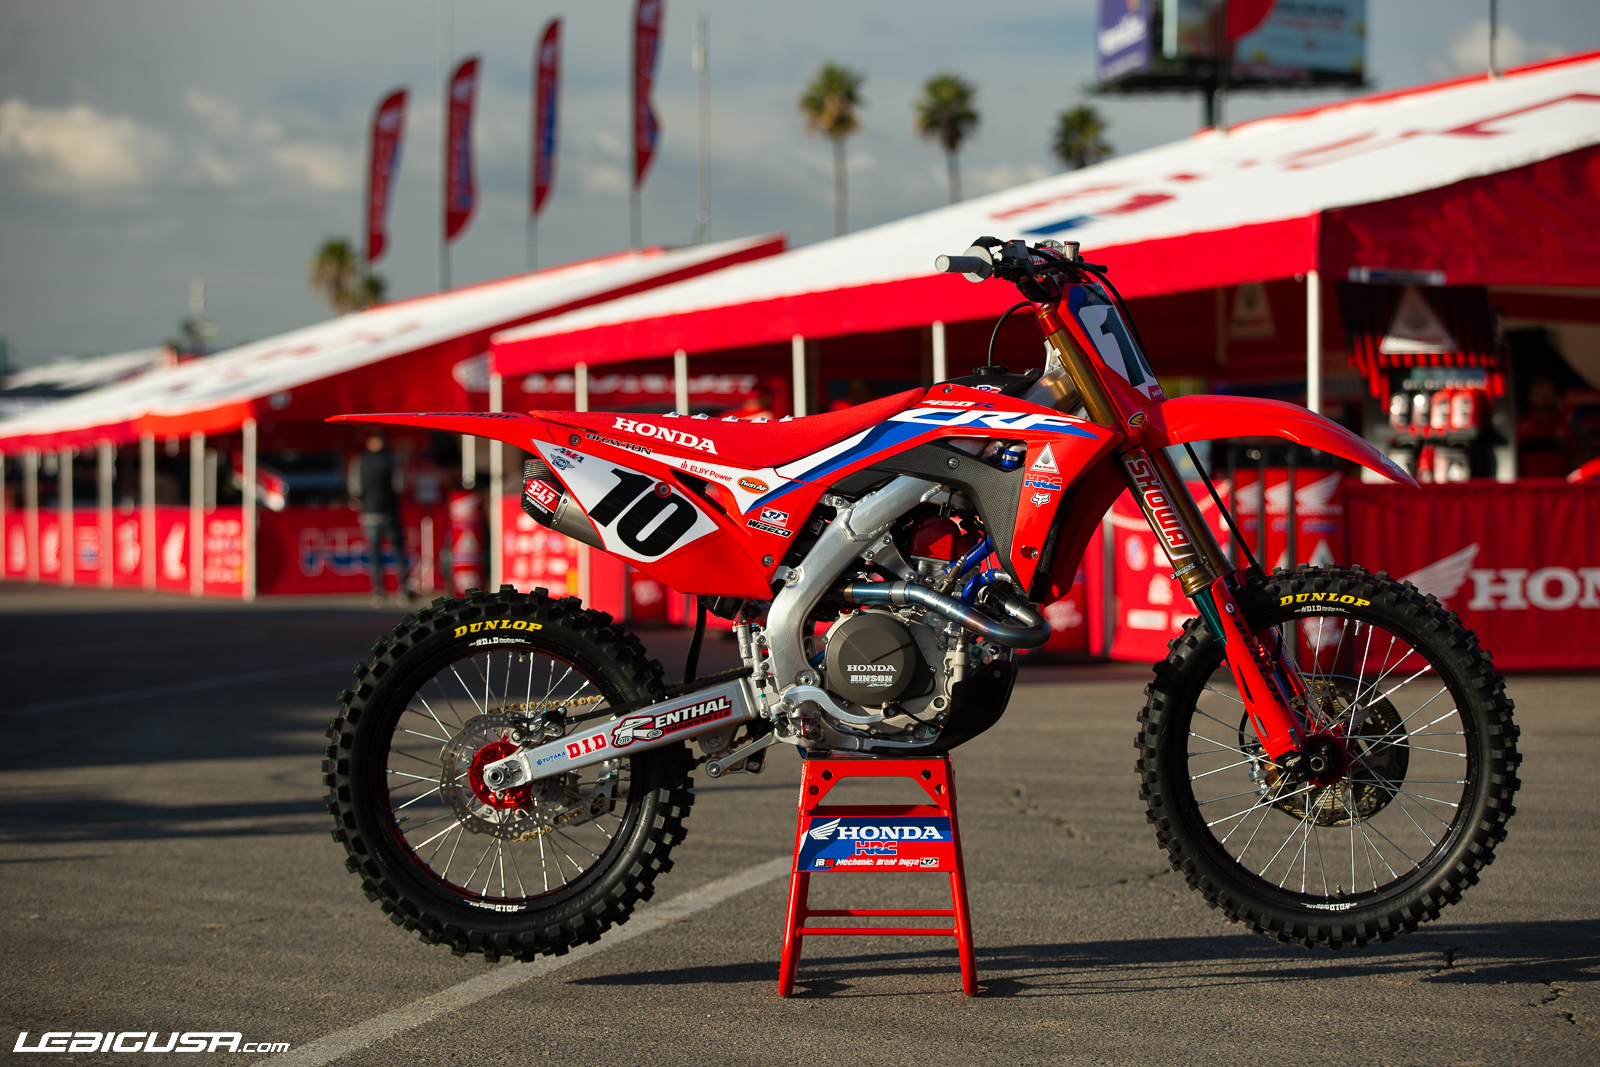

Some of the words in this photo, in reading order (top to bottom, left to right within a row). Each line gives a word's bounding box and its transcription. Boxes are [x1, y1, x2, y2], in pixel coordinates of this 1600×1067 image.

[900, 407, 1086, 430] CRF
[585, 433, 652, 455] BRAYTON
[612, 416, 718, 455] HONDA
[552, 447, 584, 464] AMA
[709, 470, 732, 482] Power
[1024, 473, 1062, 491] HRC
[527, 480, 556, 505] ヨシムラ
[740, 479, 757, 489] Twin
[756, 483, 768, 492] Air
[587, 467, 698, 557] 10
[1125, 458, 1192, 549] SHOWA
[1280, 592, 1370, 607] DUNLOP
[454, 619, 543, 639] DUNLOP
[846, 664, 897, 672] HONDA
[665, 710, 731, 734] CHAINWHEELS
[542, 751, 566, 763] YUTAKA
[837, 826, 943, 840] HONDA
[855, 841, 897, 855] HRC
[876, 858, 898, 866] Brent
